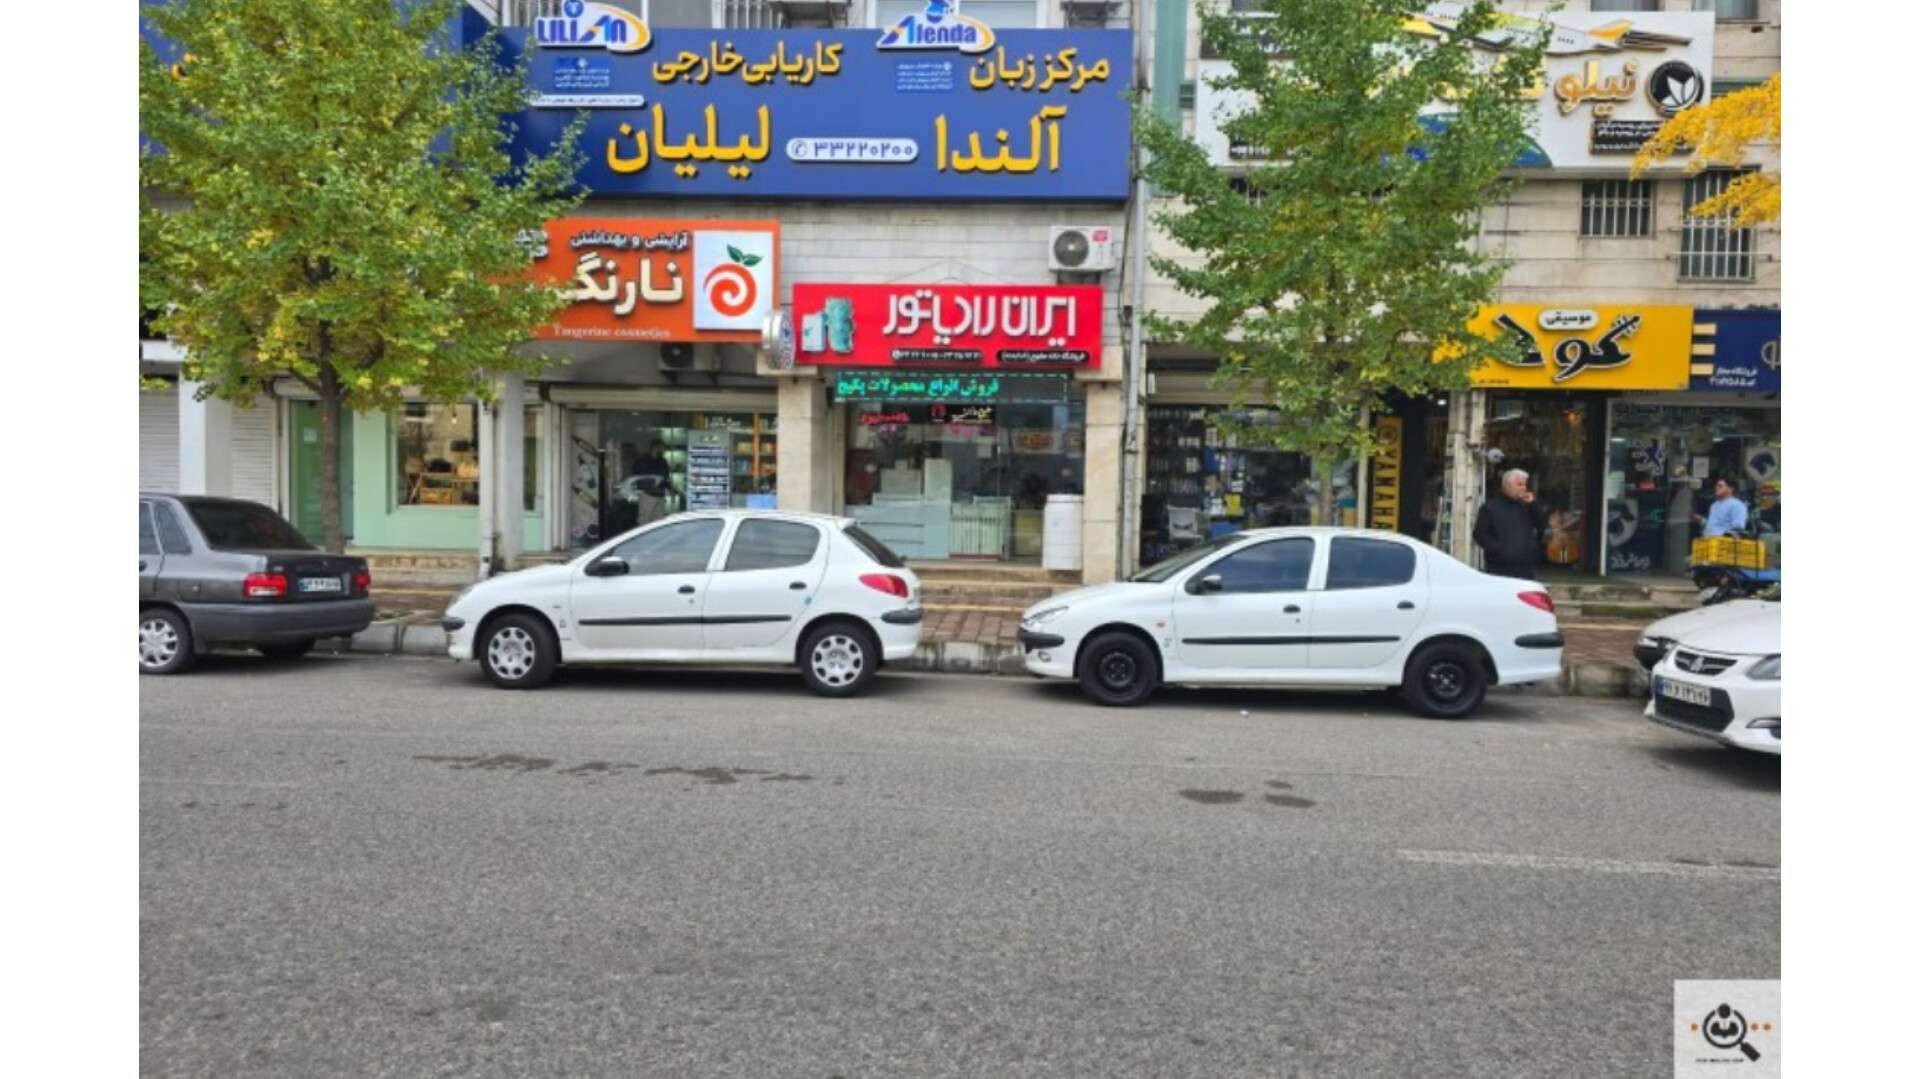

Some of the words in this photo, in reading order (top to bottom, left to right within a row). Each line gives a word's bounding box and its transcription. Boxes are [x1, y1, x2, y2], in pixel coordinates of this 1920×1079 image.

[651, 40, 743, 82] خارجی
[740, 40, 843, 84] کاریابی
[969, 46, 1037, 89] زبان
[1038, 47, 1110, 91] مرکز
[606, 103, 771, 177] لیلیان
[814, 141, 913, 158] ۳۳۲۲۰۲۰۰
[935, 105, 1067, 172] آلندا
[882, 289, 997, 345] رادیاتور
[1002, 295, 1077, 346] ایران
[1545, 311, 1592, 326] موسیقی
[868, 377, 925, 397] محصولات
[927, 377, 960, 397] انواع
[960, 377, 999, 397] فروش
